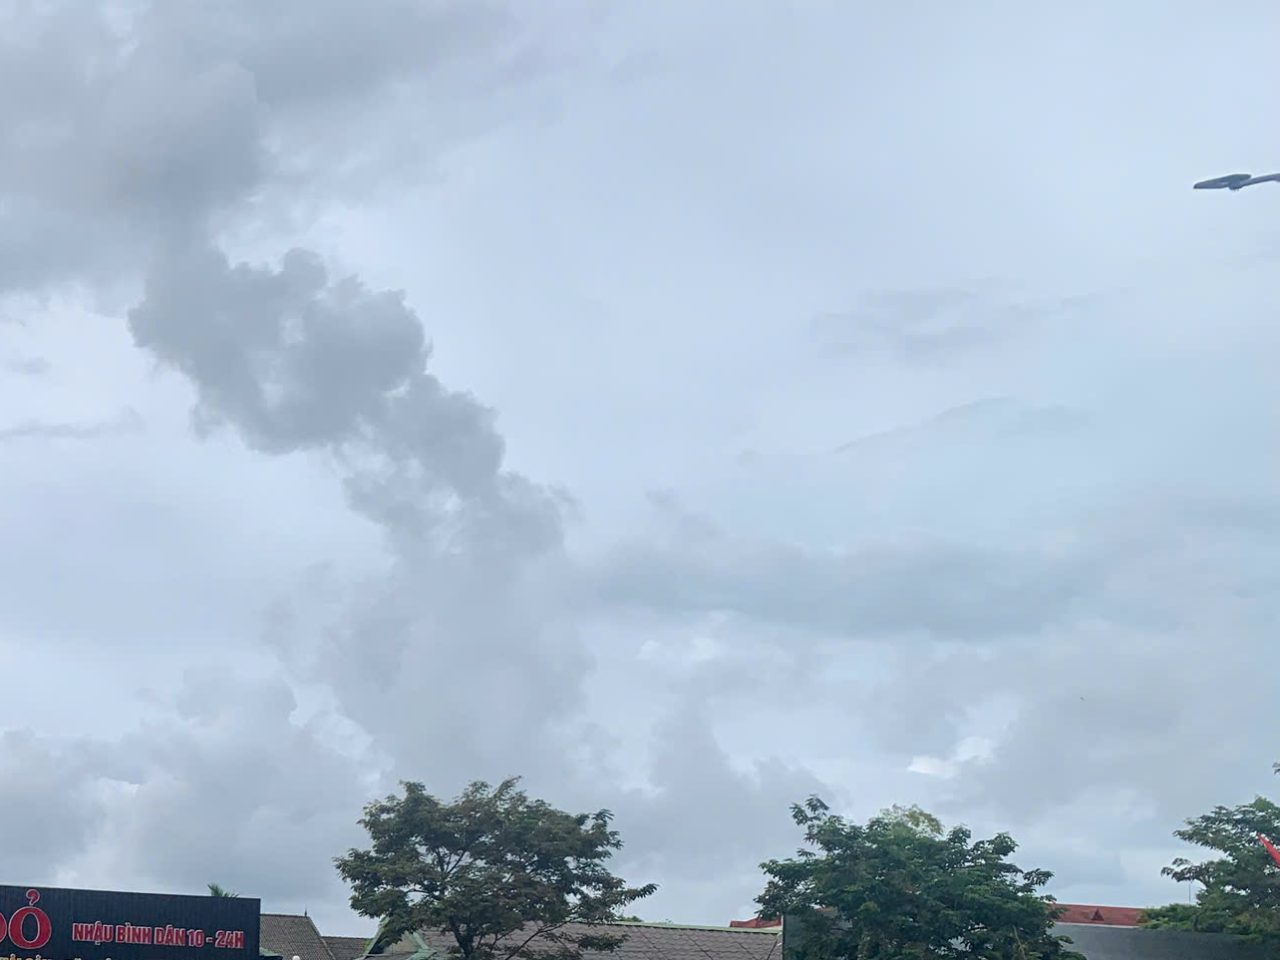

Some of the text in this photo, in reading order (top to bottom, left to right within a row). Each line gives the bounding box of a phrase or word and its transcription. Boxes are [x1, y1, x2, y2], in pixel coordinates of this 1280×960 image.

[72, 921, 114, 946] NHẬU
[187, 930, 205, 948] 10
[214, 930, 245, 949] 24H
